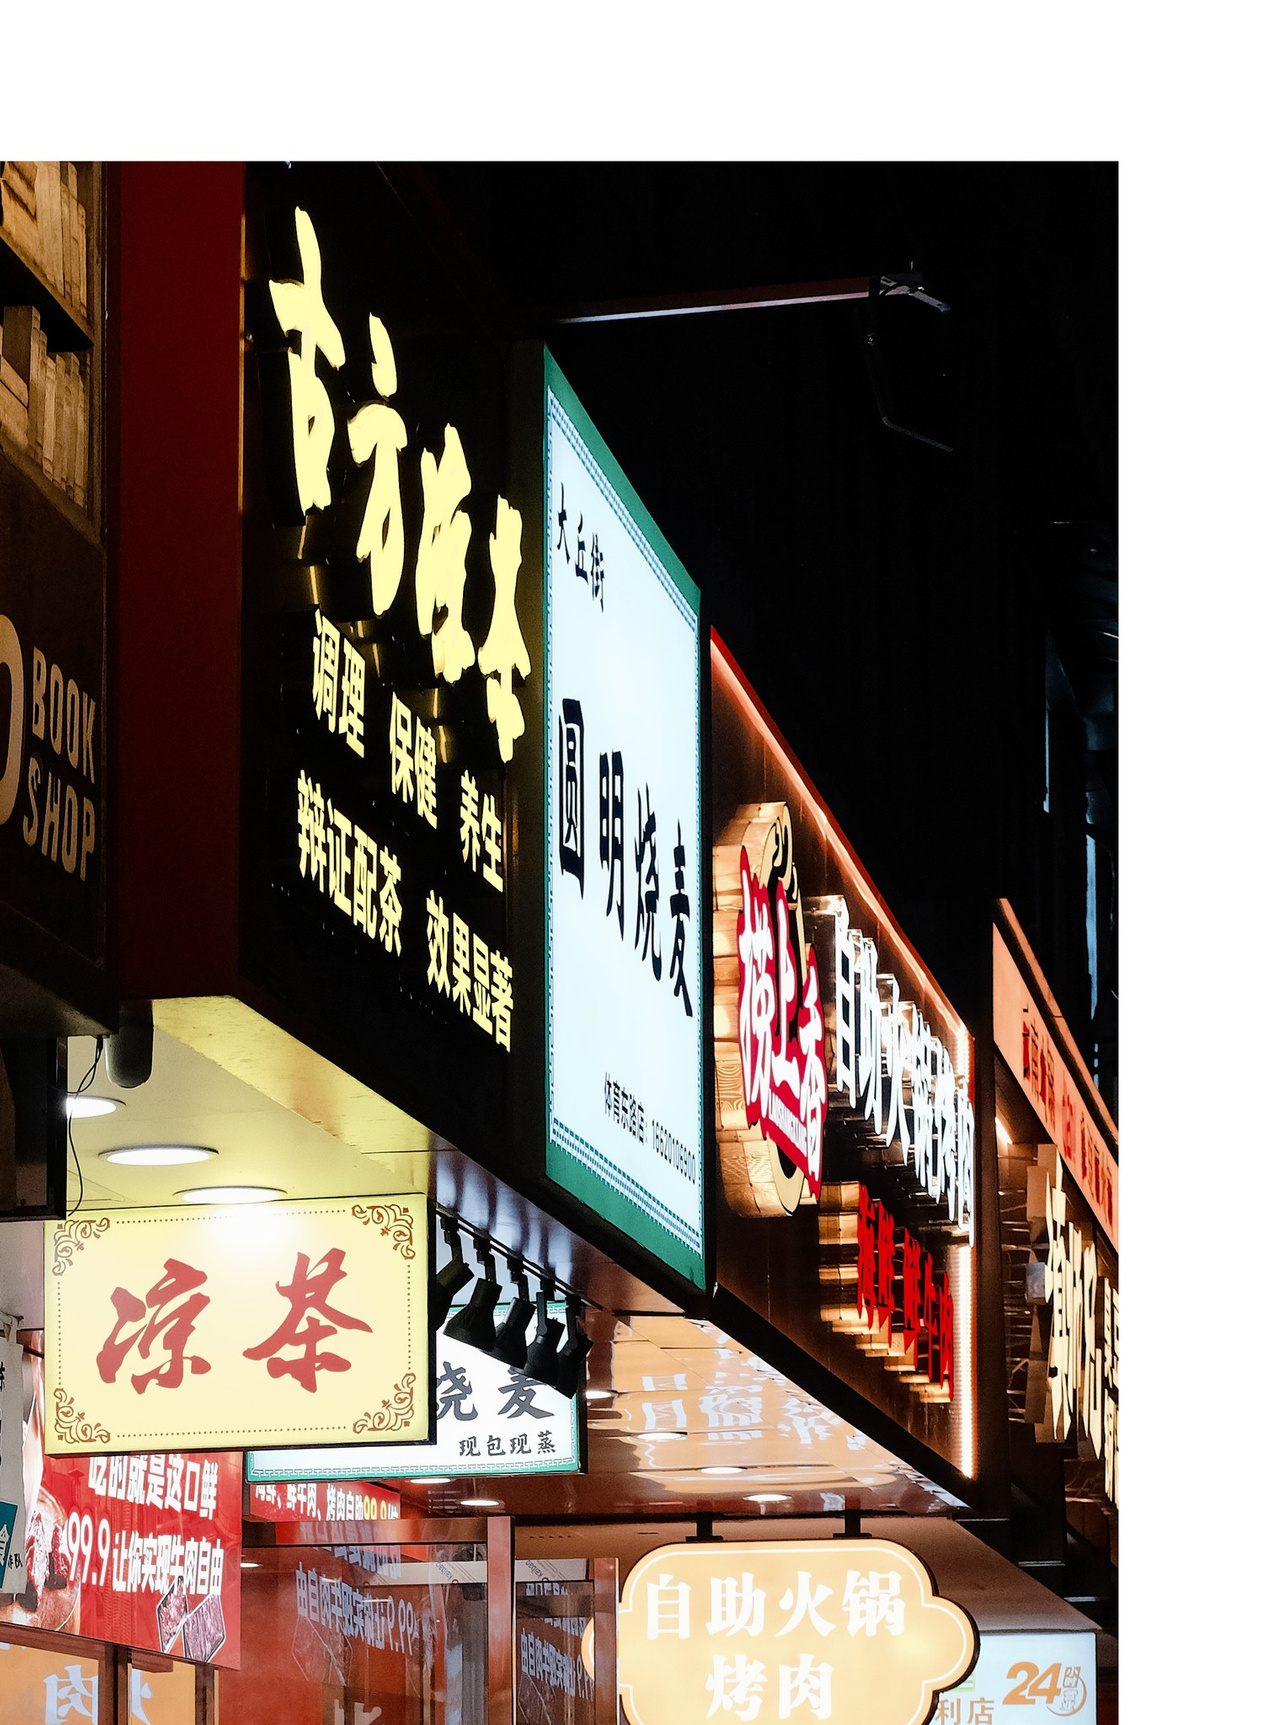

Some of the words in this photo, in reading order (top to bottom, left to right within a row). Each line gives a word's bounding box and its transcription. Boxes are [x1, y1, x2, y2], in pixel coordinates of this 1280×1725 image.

[269, 206, 531, 762] 古方凉茶
[557, 482, 607, 612] 大丘街
[32, 646, 96, 788] BOOK
[312, 609, 366, 758] 调理
[390, 691, 437, 828] 保健
[460, 770, 503, 892] 养生
[23, 757, 95, 881] SHOP
[557, 698, 694, 1018] 圆明烧麦
[426, 890, 513, 1052] 效果显著
[835, 897, 976, 1247] 自助火锅烤肉
[95, 1247, 373, 1394] 凉茶
[88, 1453, 218, 1520] 吃的就是这口鲜
[458, 1430, 556, 1456] 现包现蒸
[113, 1531, 224, 1597] 让你实现牛肉自由
[644, 1569, 907, 1640] 自助火锅
[705, 1653, 835, 1720] 烤肉
[1002, 1661, 1062, 1705] 24
